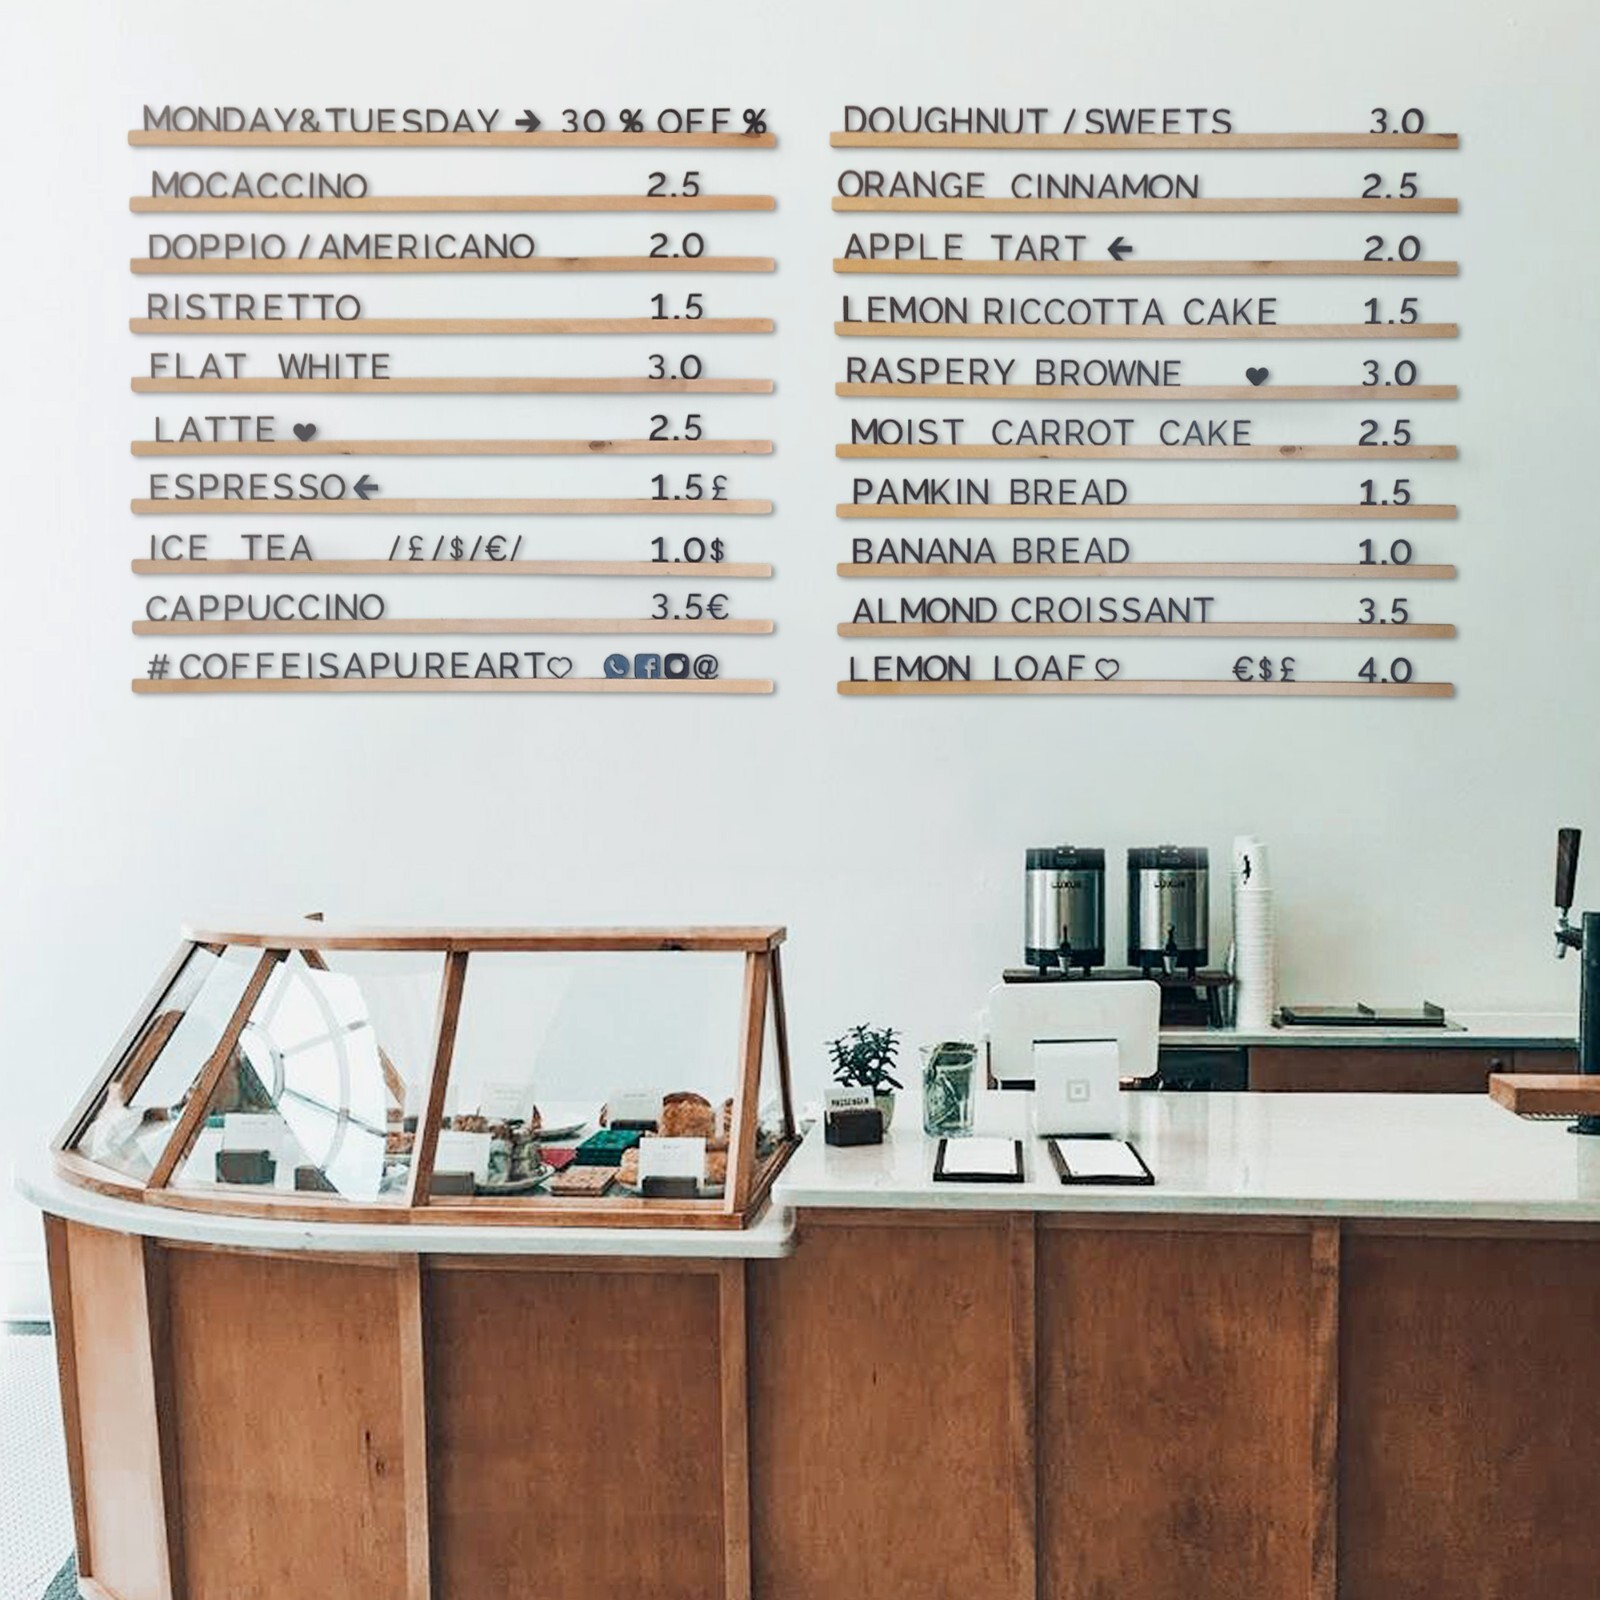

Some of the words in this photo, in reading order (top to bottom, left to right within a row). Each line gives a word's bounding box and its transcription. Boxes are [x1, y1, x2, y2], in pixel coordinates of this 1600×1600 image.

[144, 106, 498, 132] MONDAY&TUESDAY
[562, 109, 605, 132] 30
[658, 109, 730, 133] OFF
[845, 106, 1048, 133] DOUGHNUT
[1370, 108, 1424, 134] 3.0
[153, 172, 367, 198] MOCACCINO
[647, 172, 699, 197] 2.5
[838, 170, 984, 198] ORANGE
[1012, 174, 1198, 198] CINNAMON
[1362, 173, 1417, 199] 2.5
[150, 234, 285, 259] DOPPIO
[650, 233, 704, 258] 2.0
[845, 233, 962, 260] APPLE
[991, 235, 1086, 261] TART
[1364, 236, 1421, 262] 2.0
[149, 294, 360, 320] RISTRETTO
[652, 294, 703, 319] 1.5
[843, 296, 967, 324] LEMON
[985, 298, 1164, 325] RICCOTTA
[1184, 298, 1276, 325] CAKE
[1365, 298, 1417, 324] 1.5
[152, 354, 246, 378] FLAT
[279, 354, 389, 379] WHITE
[649, 354, 702, 379] 3.0
[847, 357, 1015, 385] RASPERY
[1036, 359, 1180, 386] BROWNE
[1363, 360, 1417, 386] 3.0
[156, 417, 274, 442] LATTE
[649, 414, 701, 441] 2.5
[852, 419, 964, 445] MOIST
[992, 419, 1134, 445] CARROT
[1160, 420, 1251, 446] CAKE
[1359, 420, 1410, 446] 2.5
[151, 474, 345, 500] ESPRESSO
[854, 479, 988, 504] PAMKIN
[1011, 479, 1127, 505] BREAD
[1360, 479, 1411, 506] 1.5
[152, 535, 207, 560] ICE
[241, 535, 312, 561] TEA
[652, 537, 724, 563] 1.0$
[853, 538, 996, 564] BANANA
[1013, 538, 1129, 564] BREAD
[1359, 539, 1412, 566] 1.0
[147, 594, 384, 621] CAPPUCCINO
[652, 594, 728, 620] 3.5€
[853, 597, 997, 624] ALMOND
[1012, 597, 1214, 623] CROISSANT
[1358, 598, 1408, 624] 3.5
[850, 655, 971, 682] LEMON
[994, 655, 1085, 682] LOAF
[1358, 657, 1412, 683] 4.0
